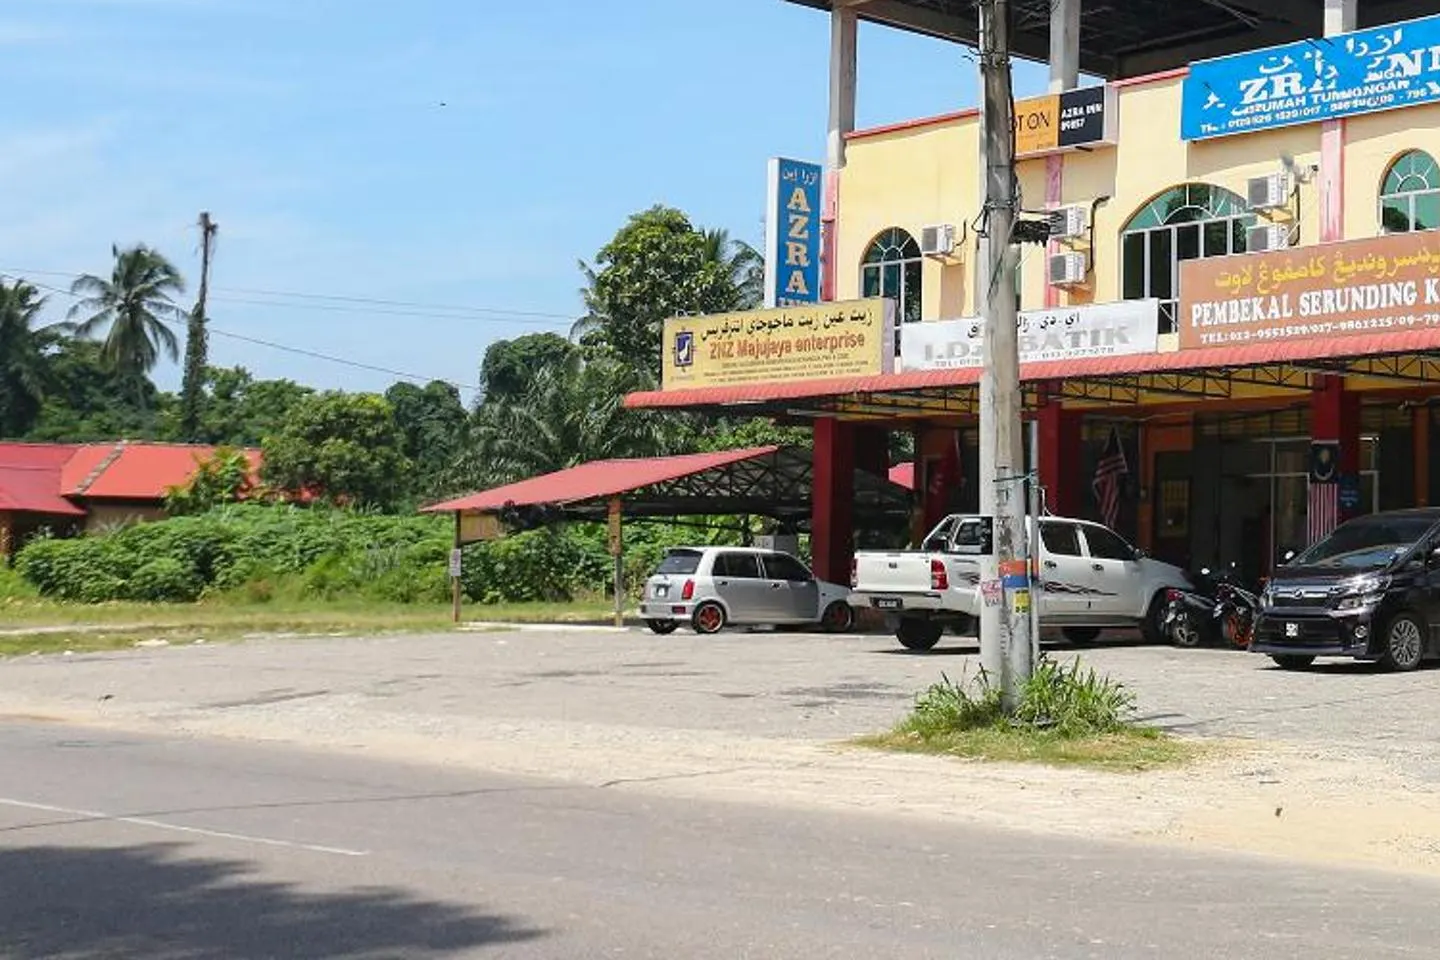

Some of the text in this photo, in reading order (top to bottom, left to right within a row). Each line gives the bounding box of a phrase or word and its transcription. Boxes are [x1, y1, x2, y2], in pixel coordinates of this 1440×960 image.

[1191, 290, 1293, 328] PEMBEKAL
[1299, 279, 1418, 317] SERUNDING
[736, 336, 792, 361] Majujaya
[795, 330, 865, 357] enterprise
